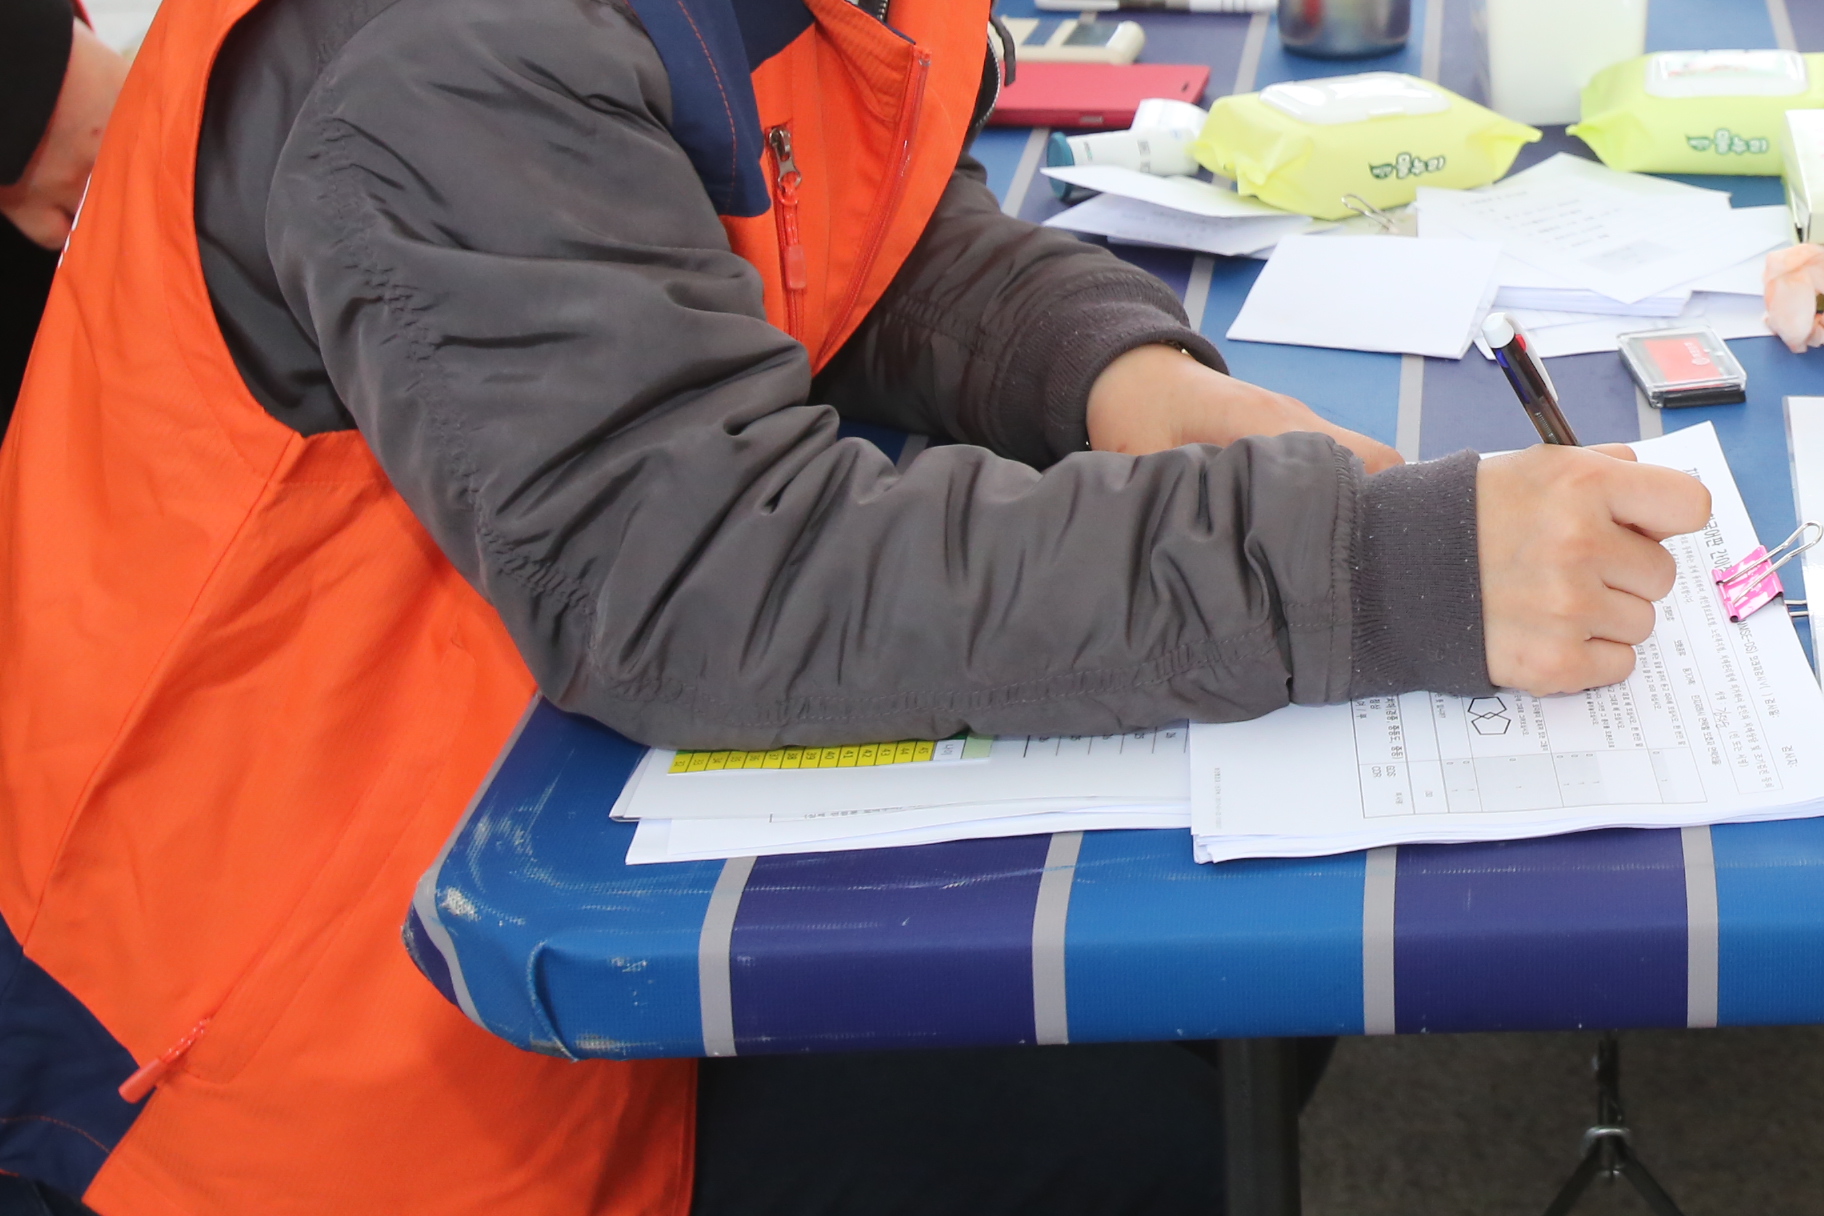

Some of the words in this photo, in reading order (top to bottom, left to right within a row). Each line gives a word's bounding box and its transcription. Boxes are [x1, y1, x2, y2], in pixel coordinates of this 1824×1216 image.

[1703, 514, 1726, 547] 국어판
[786, 752, 798, 760] 38
[805, 751, 817, 760] 39
[824, 751, 836, 760] 40
[842, 751, 854, 759] 41
[861, 750, 873, 758] 42
[880, 748, 892, 757] 43
